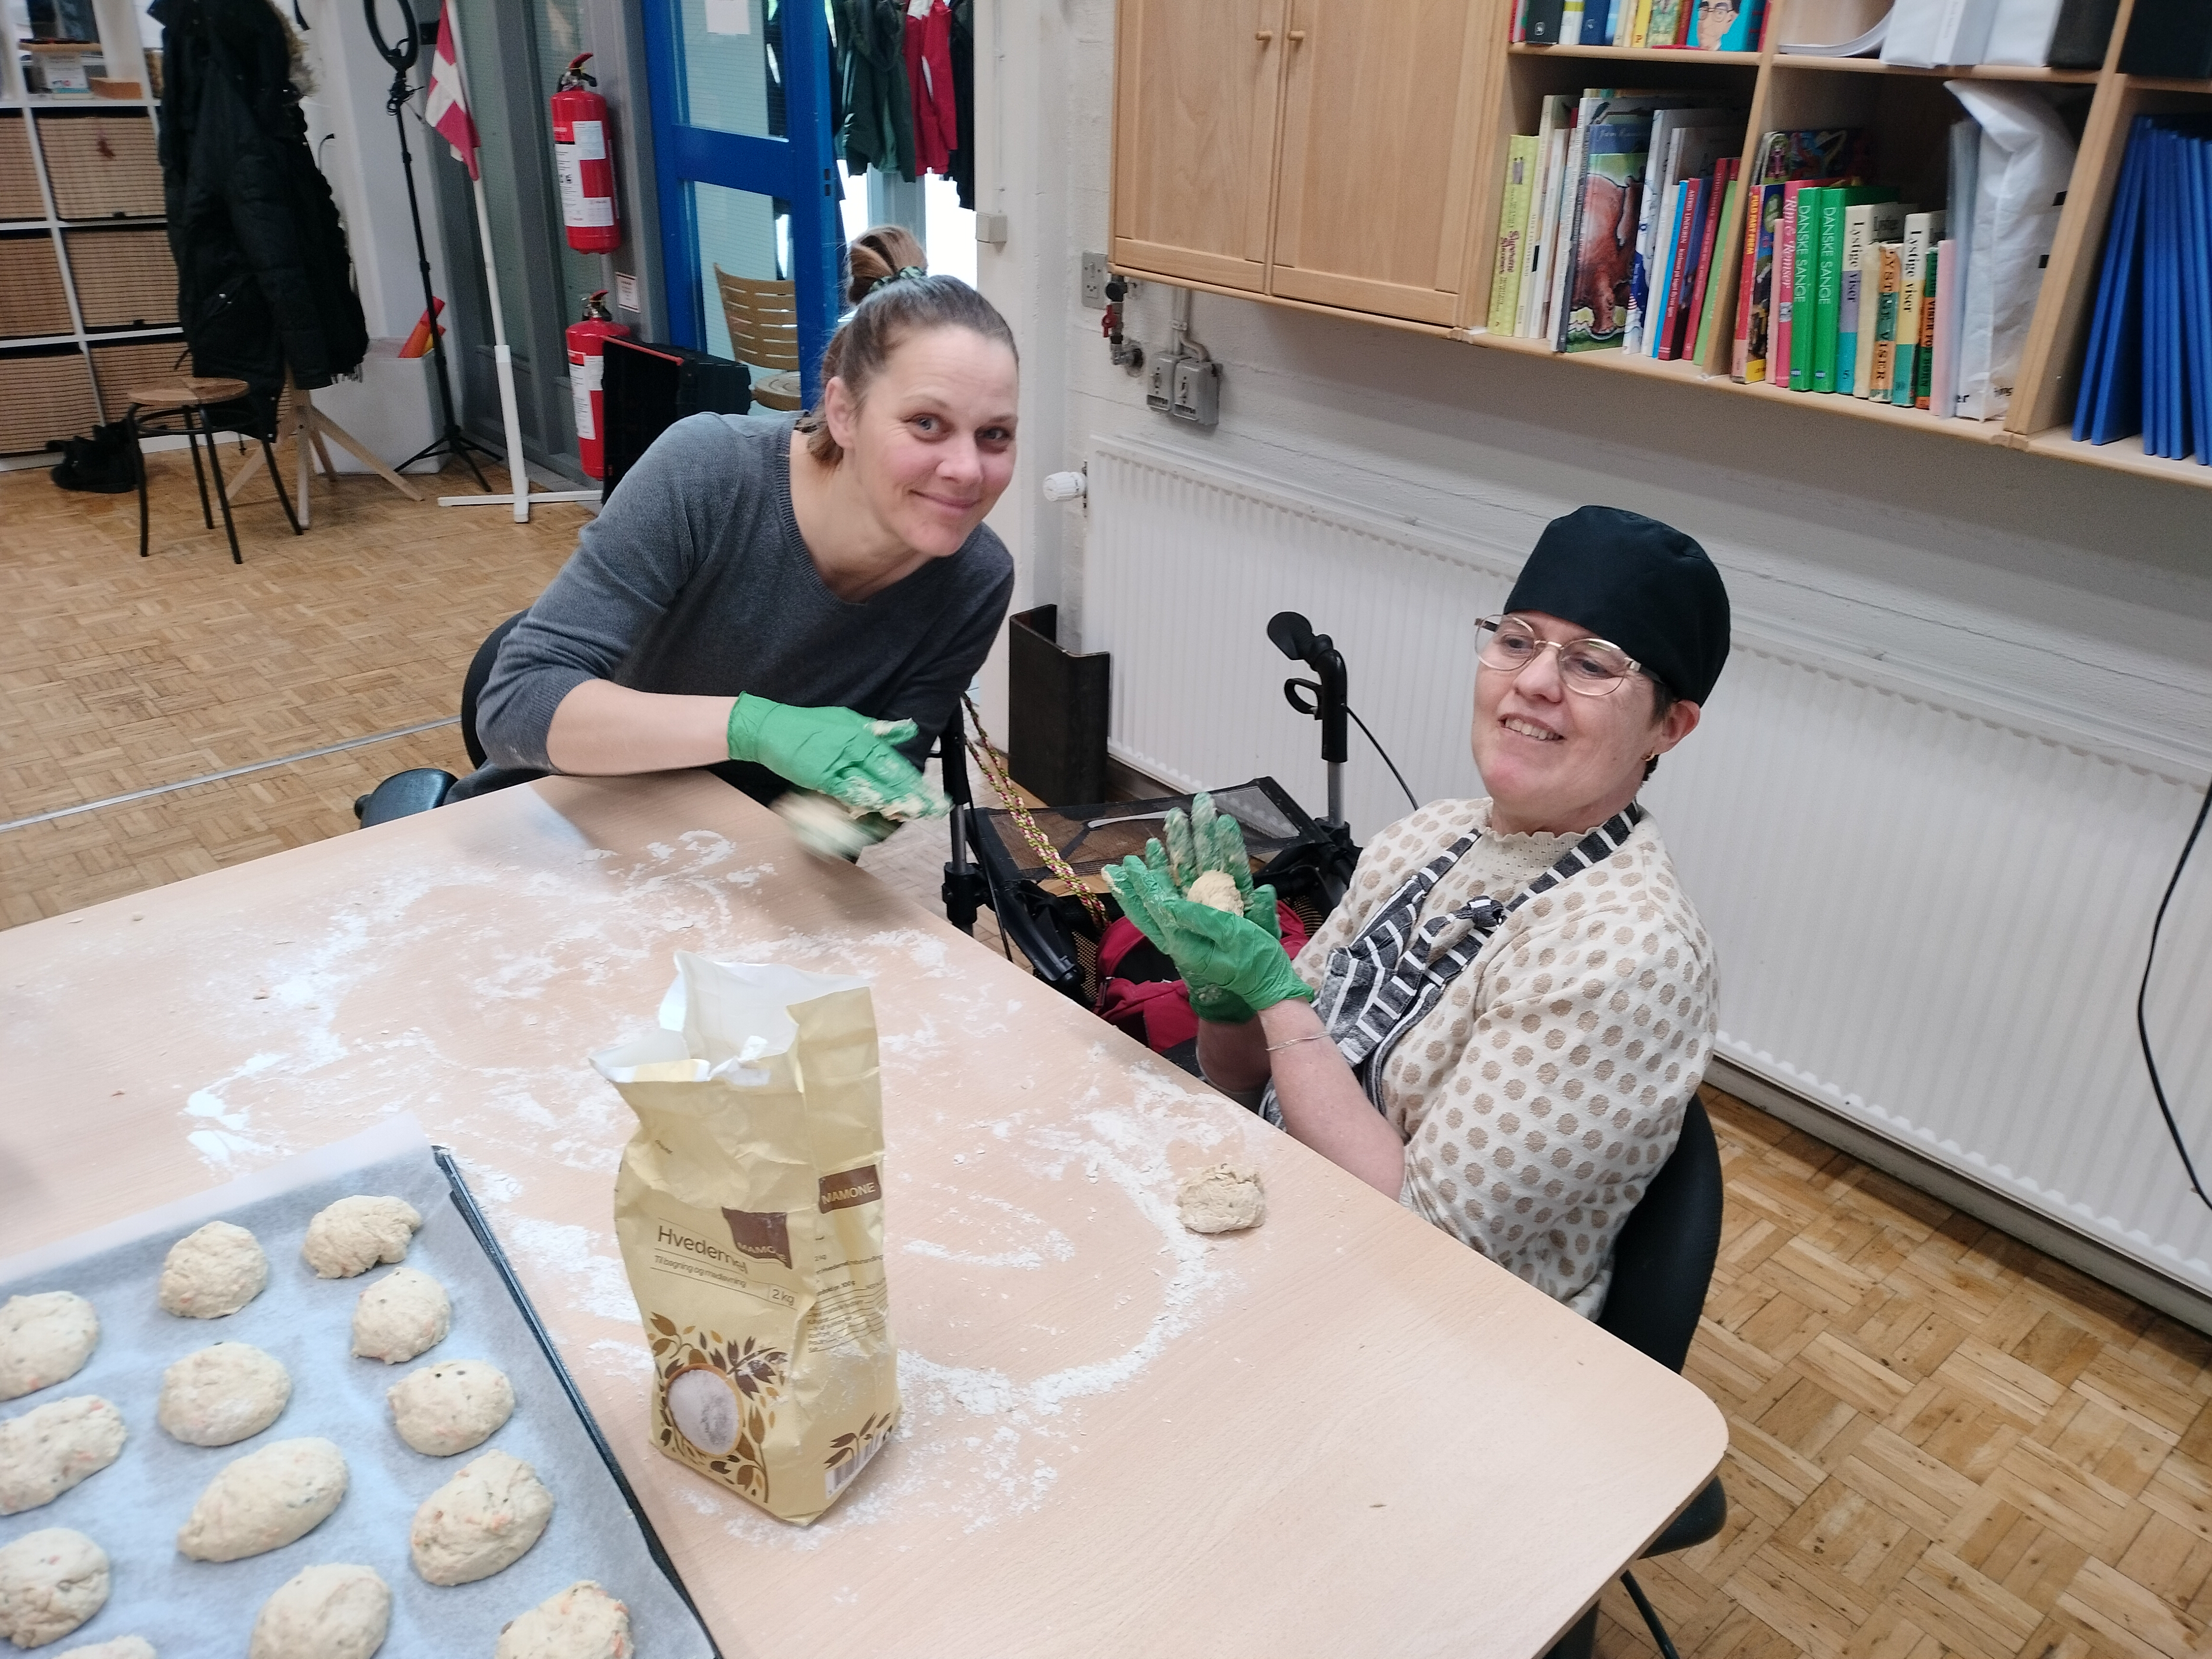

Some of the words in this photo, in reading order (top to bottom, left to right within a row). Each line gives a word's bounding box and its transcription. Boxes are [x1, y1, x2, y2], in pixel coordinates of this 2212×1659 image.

[1686, 189, 1695, 211] ASTRID
[1783, 196, 1797, 224] Rim
[1680, 212, 1691, 243] LINDGREN
[1784, 226, 1796, 236] &
[1797, 205, 1811, 255] DANSKE
[1821, 207, 1837, 257] DANSKE
[1848, 221, 1865, 268] Lystige
[1781, 241, 1796, 289] Remser
[1905, 230, 1923, 277] Lystige
[1794, 259, 1808, 303] SANGE
[1818, 261, 1833, 305] SANGE
[1847, 273, 1861, 303] viser
[1903, 283, 1919, 313] viser
[1876, 331, 1891, 379] VISER
[821, 1182, 876, 1205] MAMONE
[657, 1225, 749, 1274] Hvedemel
[663, 1258, 694, 1273] bagning
[694, 1267, 704, 1276] og
[704, 1270, 747, 1288] madlavning
[772, 1289, 780, 1300] 2
[780, 1290, 795, 1306] kg
